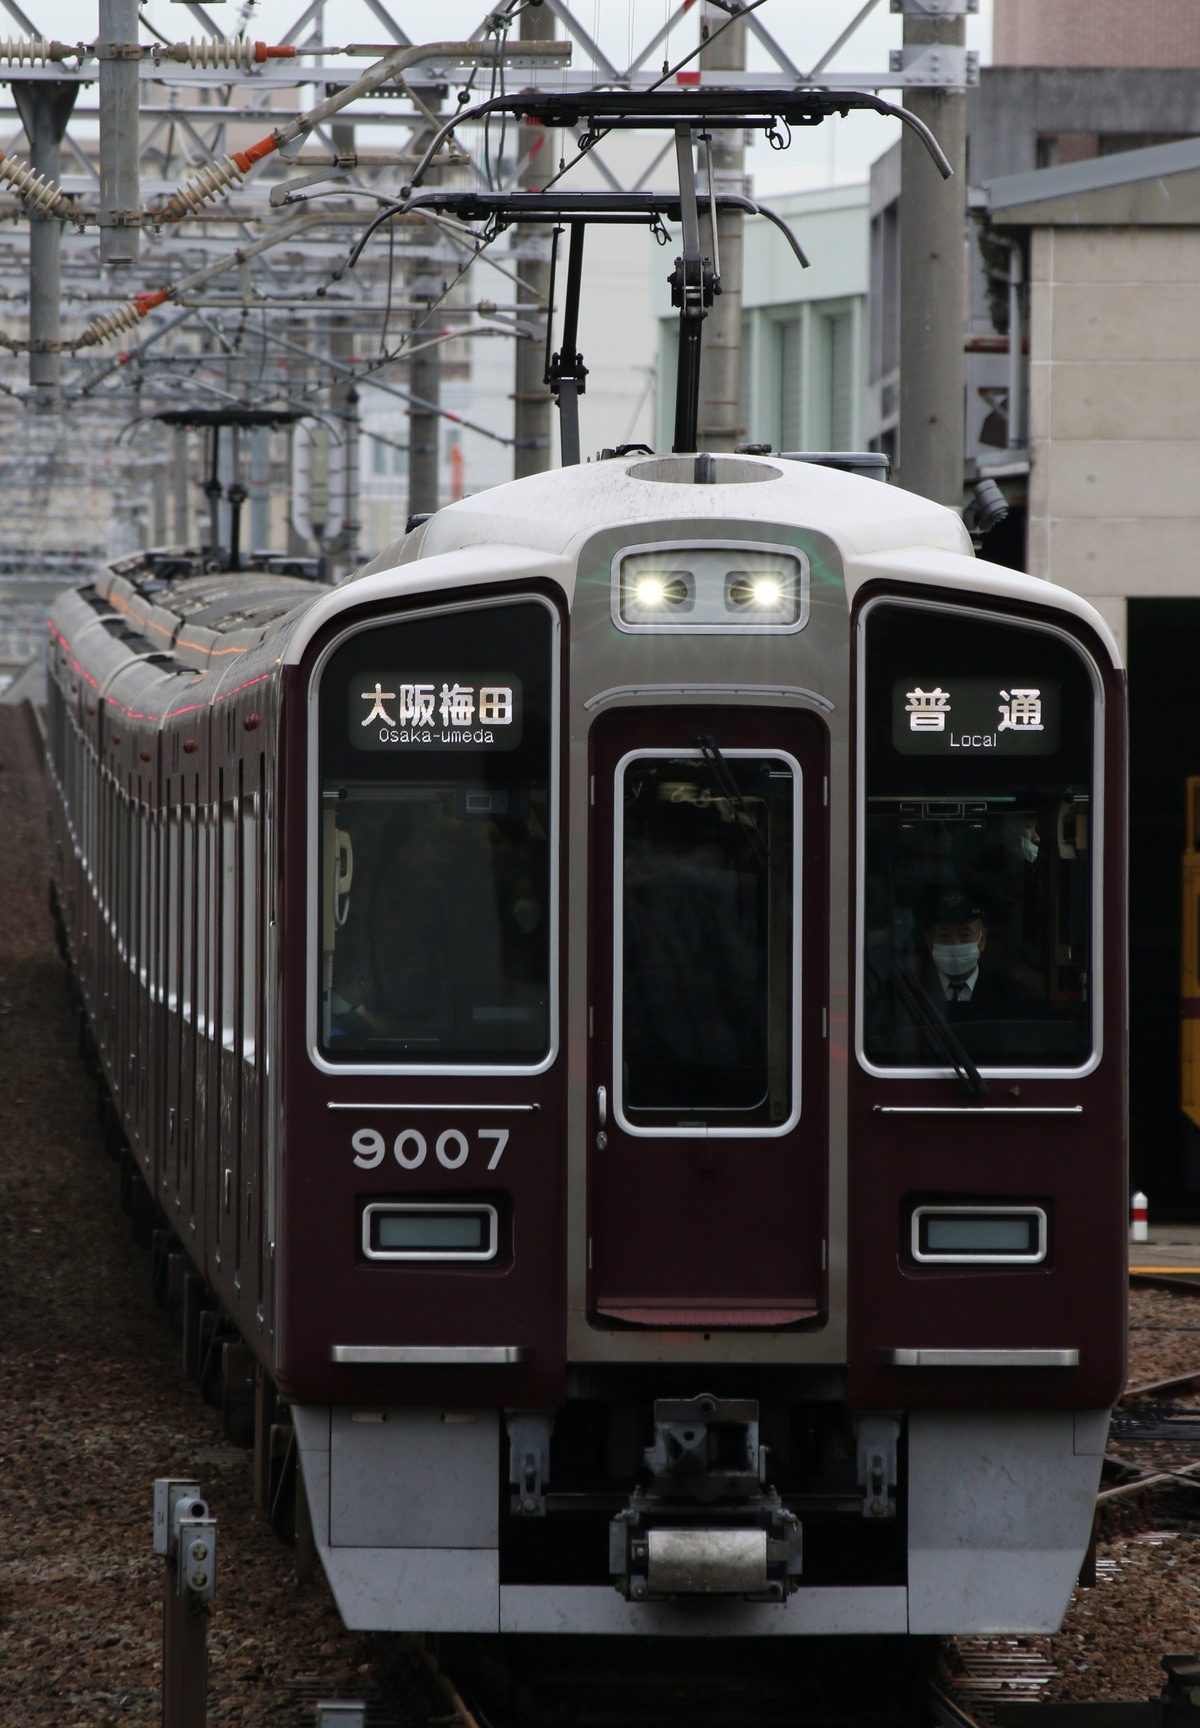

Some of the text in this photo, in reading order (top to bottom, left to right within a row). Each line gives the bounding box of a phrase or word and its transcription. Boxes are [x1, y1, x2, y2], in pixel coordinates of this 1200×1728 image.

[360, 682, 514, 728] 大阪梅田
[377, 728, 495, 744] Osaka-umeda
[949, 733, 998, 748] Local
[351, 1128, 510, 1170] 9007
